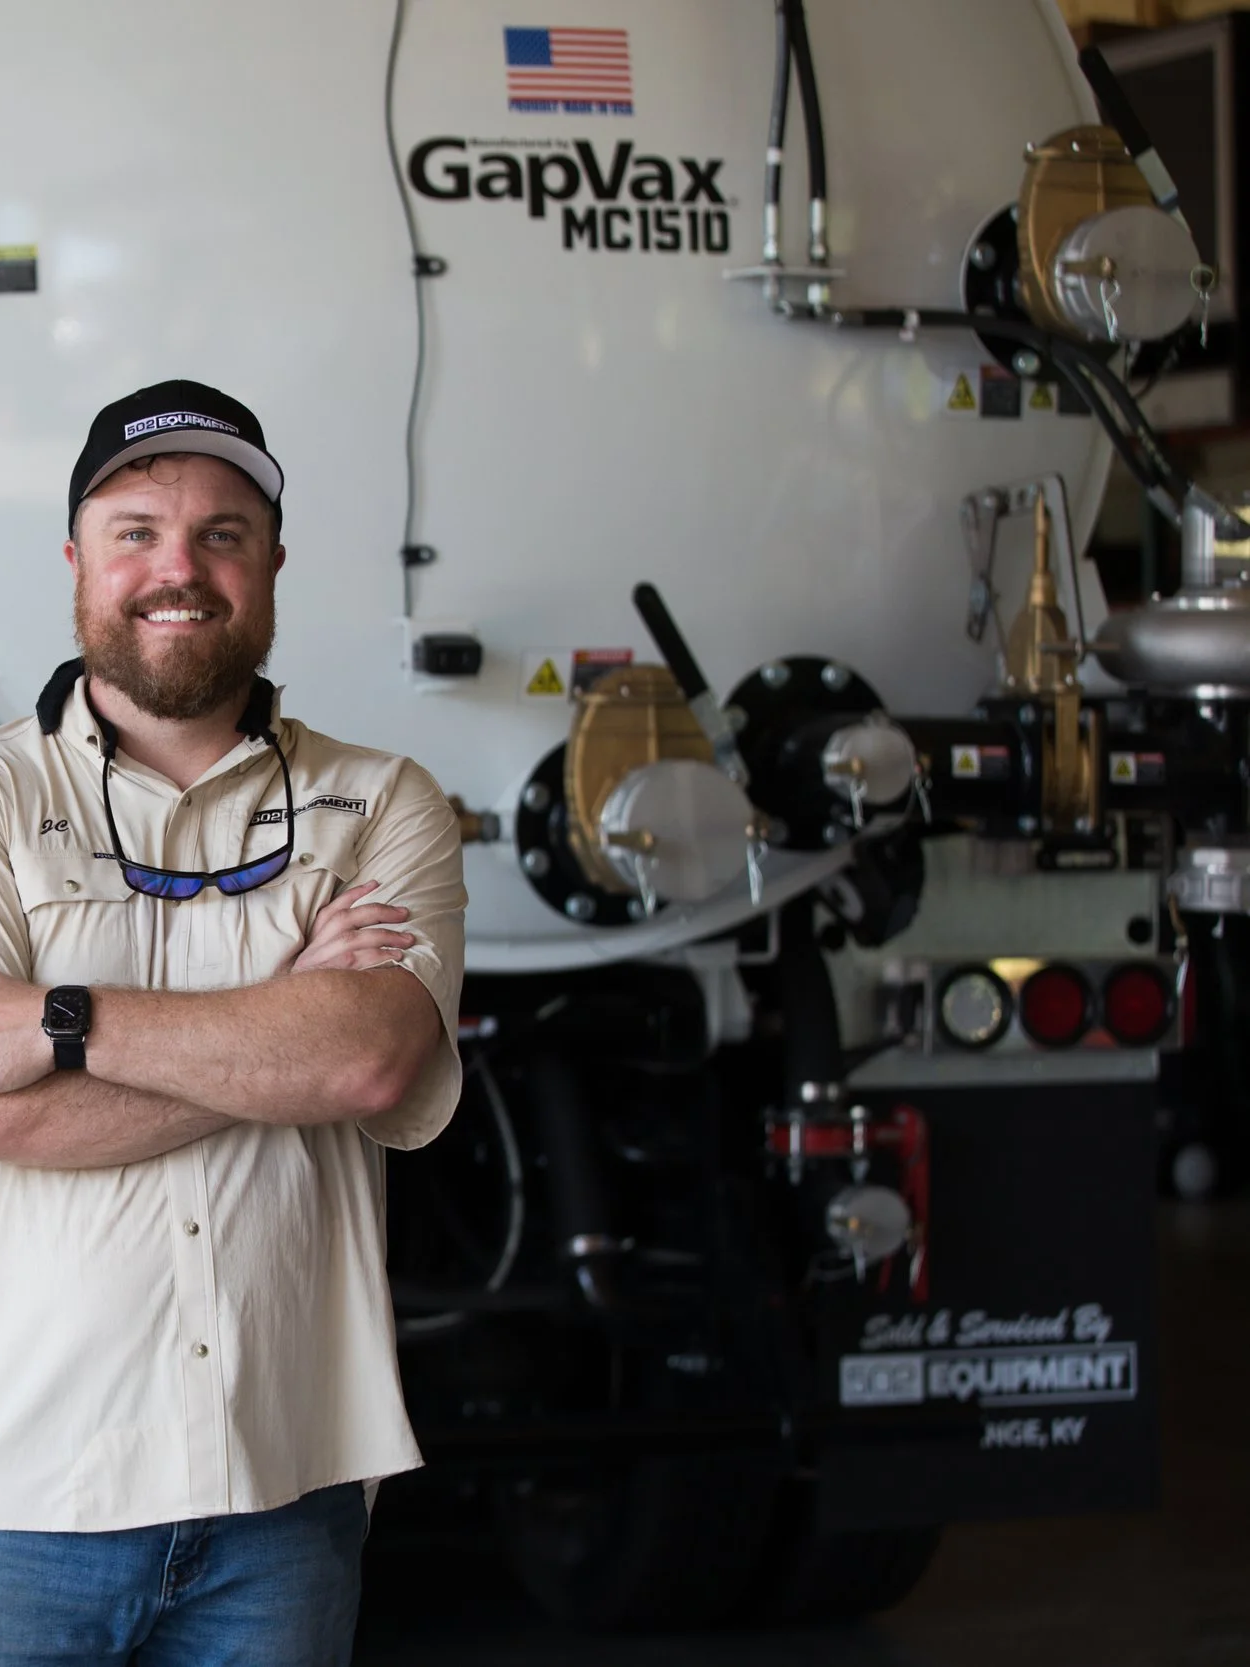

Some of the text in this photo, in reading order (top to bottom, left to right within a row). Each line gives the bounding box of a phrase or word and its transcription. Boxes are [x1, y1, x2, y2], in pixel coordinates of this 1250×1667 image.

[407, 137, 726, 219] GapVax
[562, 207, 731, 254] MC1510
[127, 419, 155, 435] 502
[251, 811, 281, 823] 502
[860, 1313, 926, 1349] Sold
[926, 1308, 950, 1344] &
[1071, 1302, 1113, 1346] By
[927, 1352, 1128, 1402] EQUIPMENT
[1051, 1415, 1089, 1447] KY
